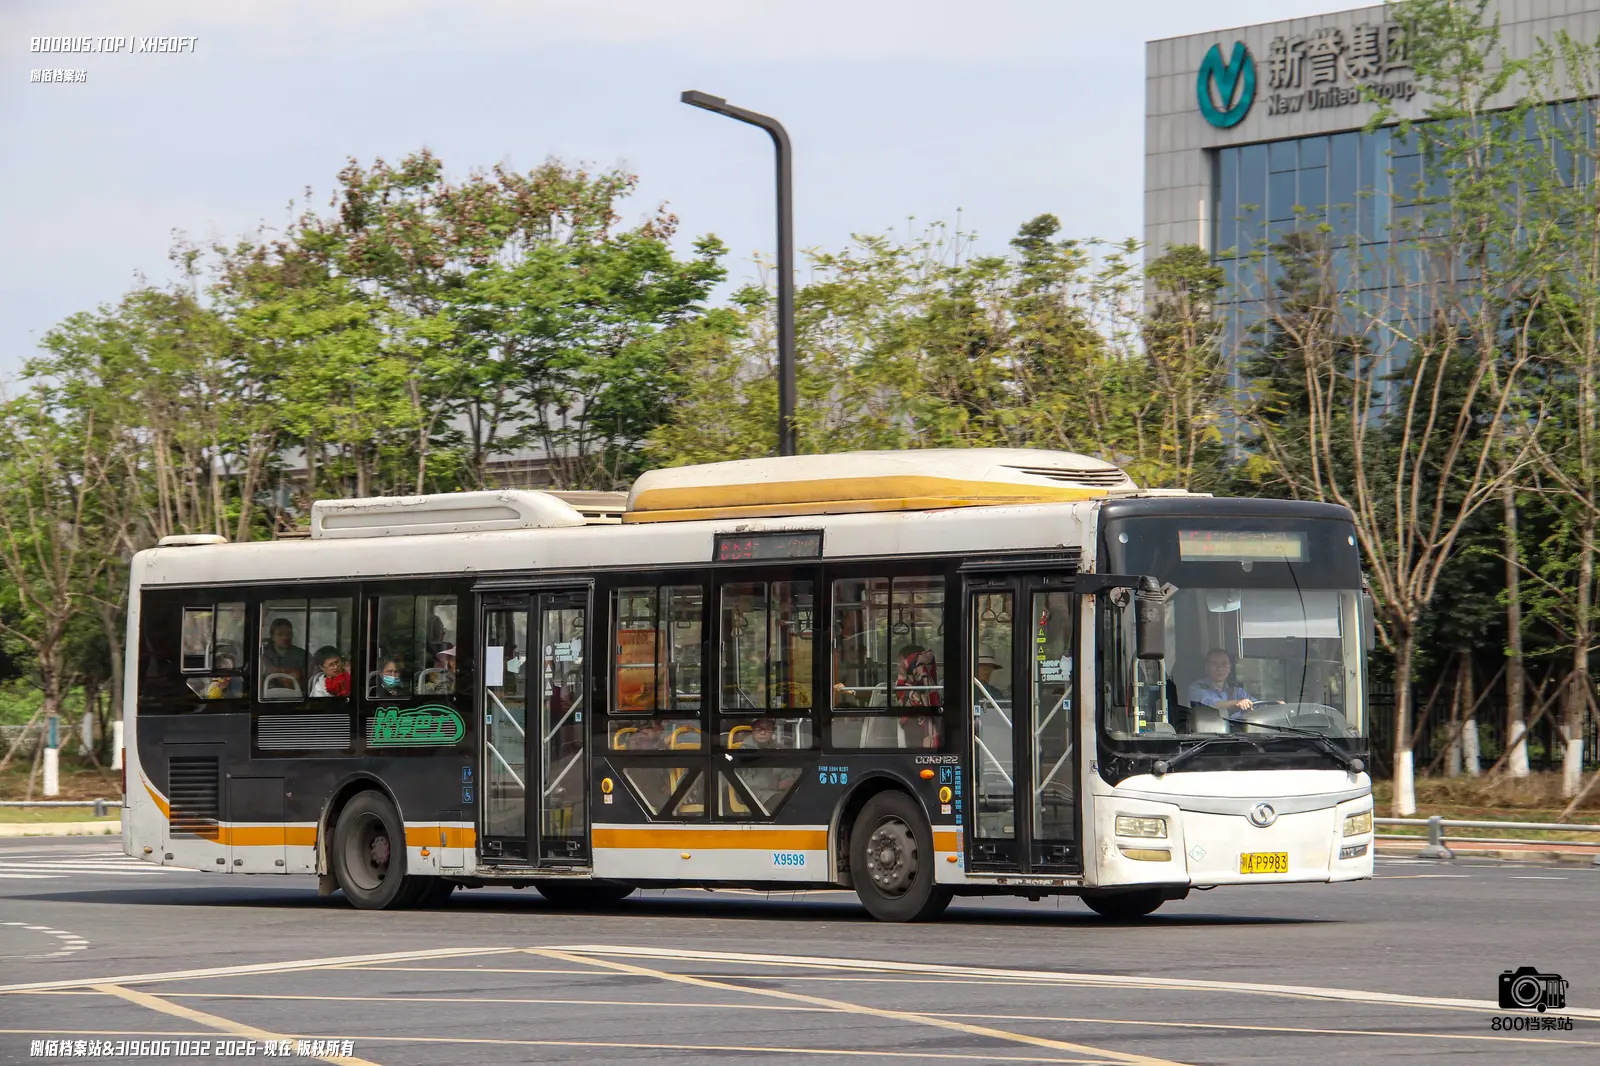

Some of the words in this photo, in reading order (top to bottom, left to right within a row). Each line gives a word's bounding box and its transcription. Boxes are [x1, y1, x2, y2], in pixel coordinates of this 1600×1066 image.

[1268, 94, 1304, 115] New
[1306, 87, 1360, 110] United
[773, 853, 805, 866] X9598
